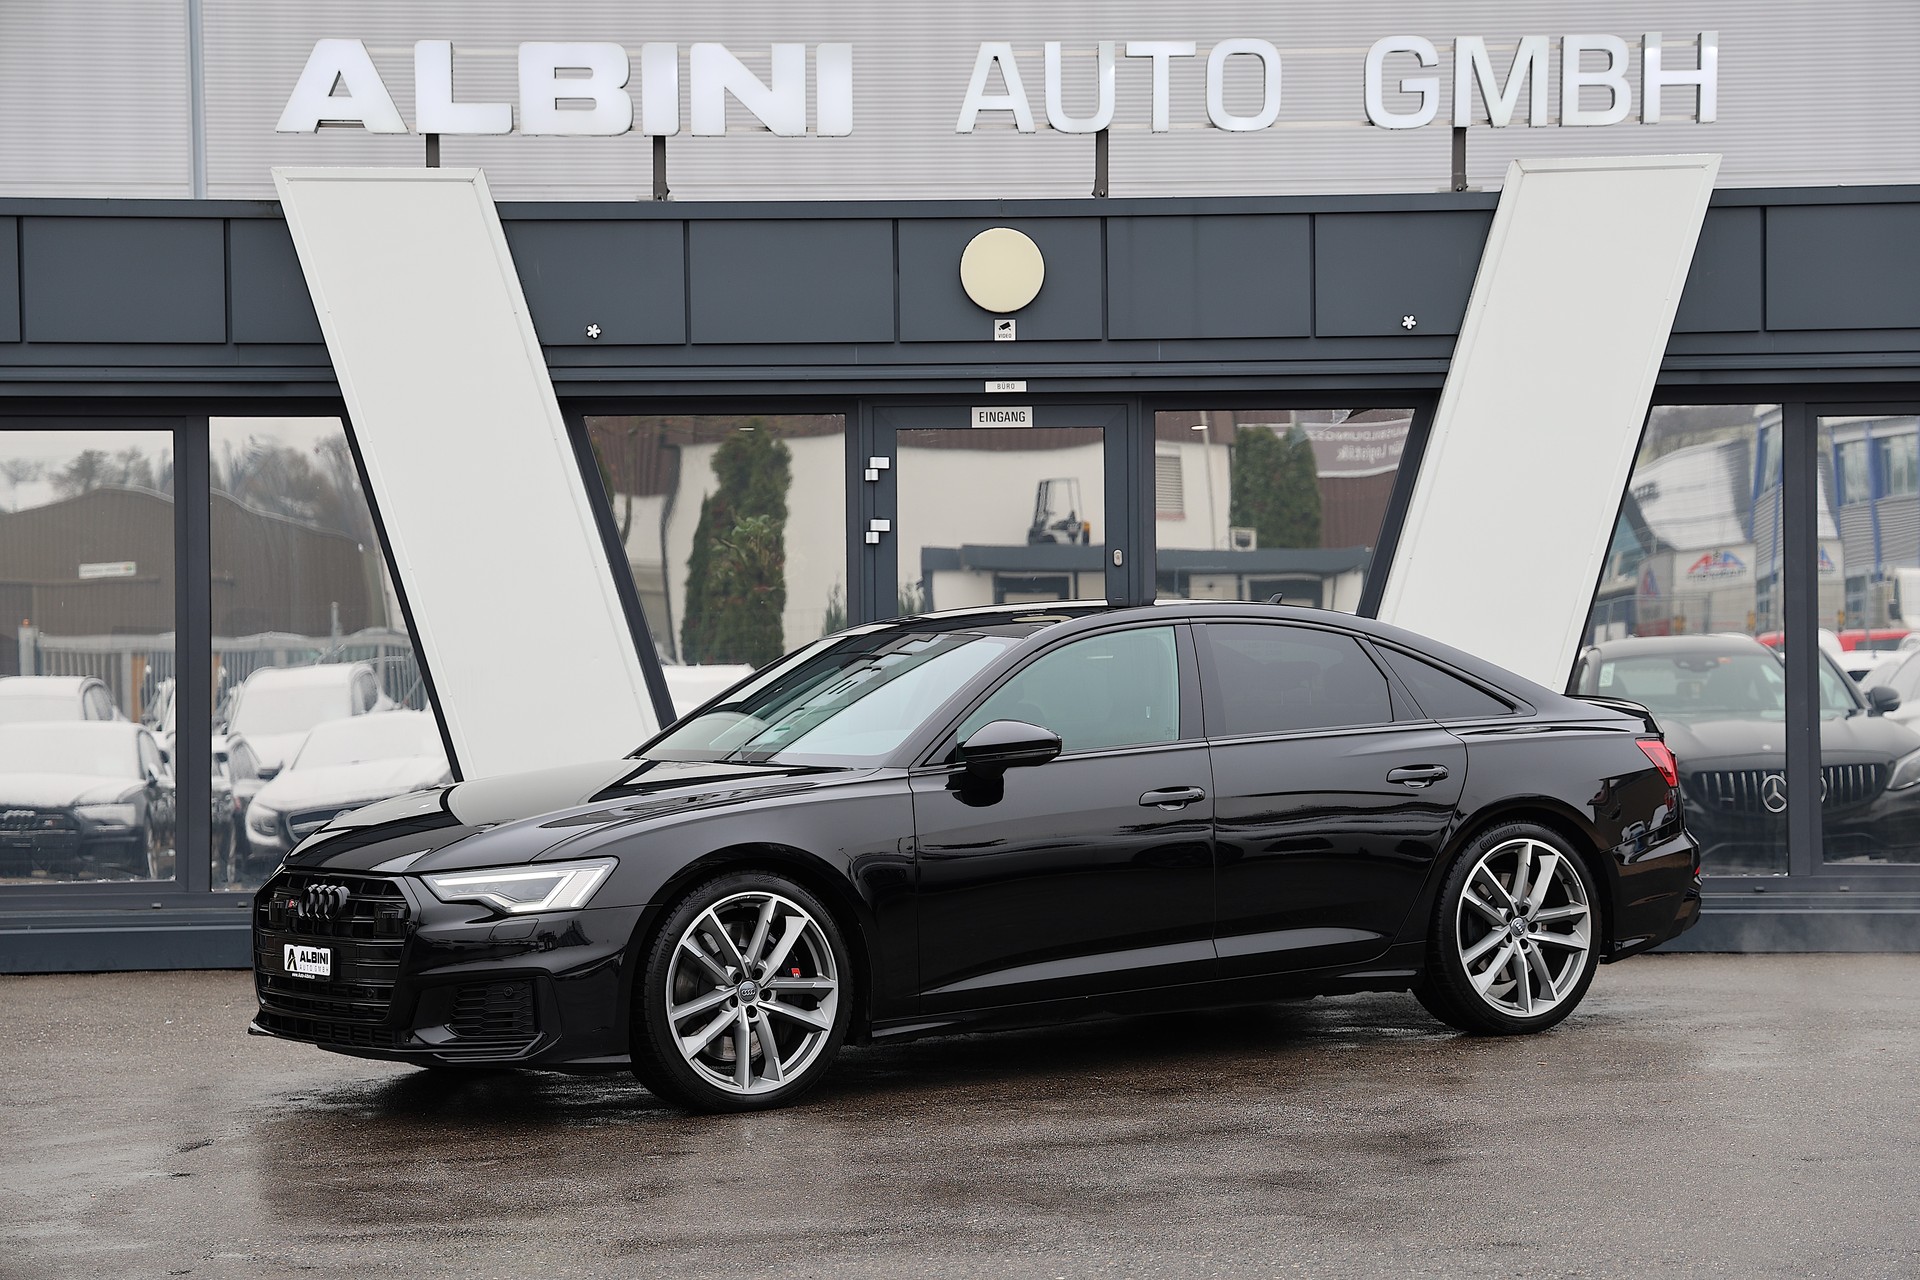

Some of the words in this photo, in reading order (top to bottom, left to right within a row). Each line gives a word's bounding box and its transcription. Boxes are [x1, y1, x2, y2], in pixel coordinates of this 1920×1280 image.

[275, 38, 853, 138] ALBINI
[955, 38, 1282, 134] AUTO
[1363, 31, 1719, 130] GMBH
[996, 382, 1016, 390] BÜRO
[979, 411, 1026, 423] EINGANG
[1480, 825, 1518, 851] Continental
[299, 950, 329, 965] ALBINI
